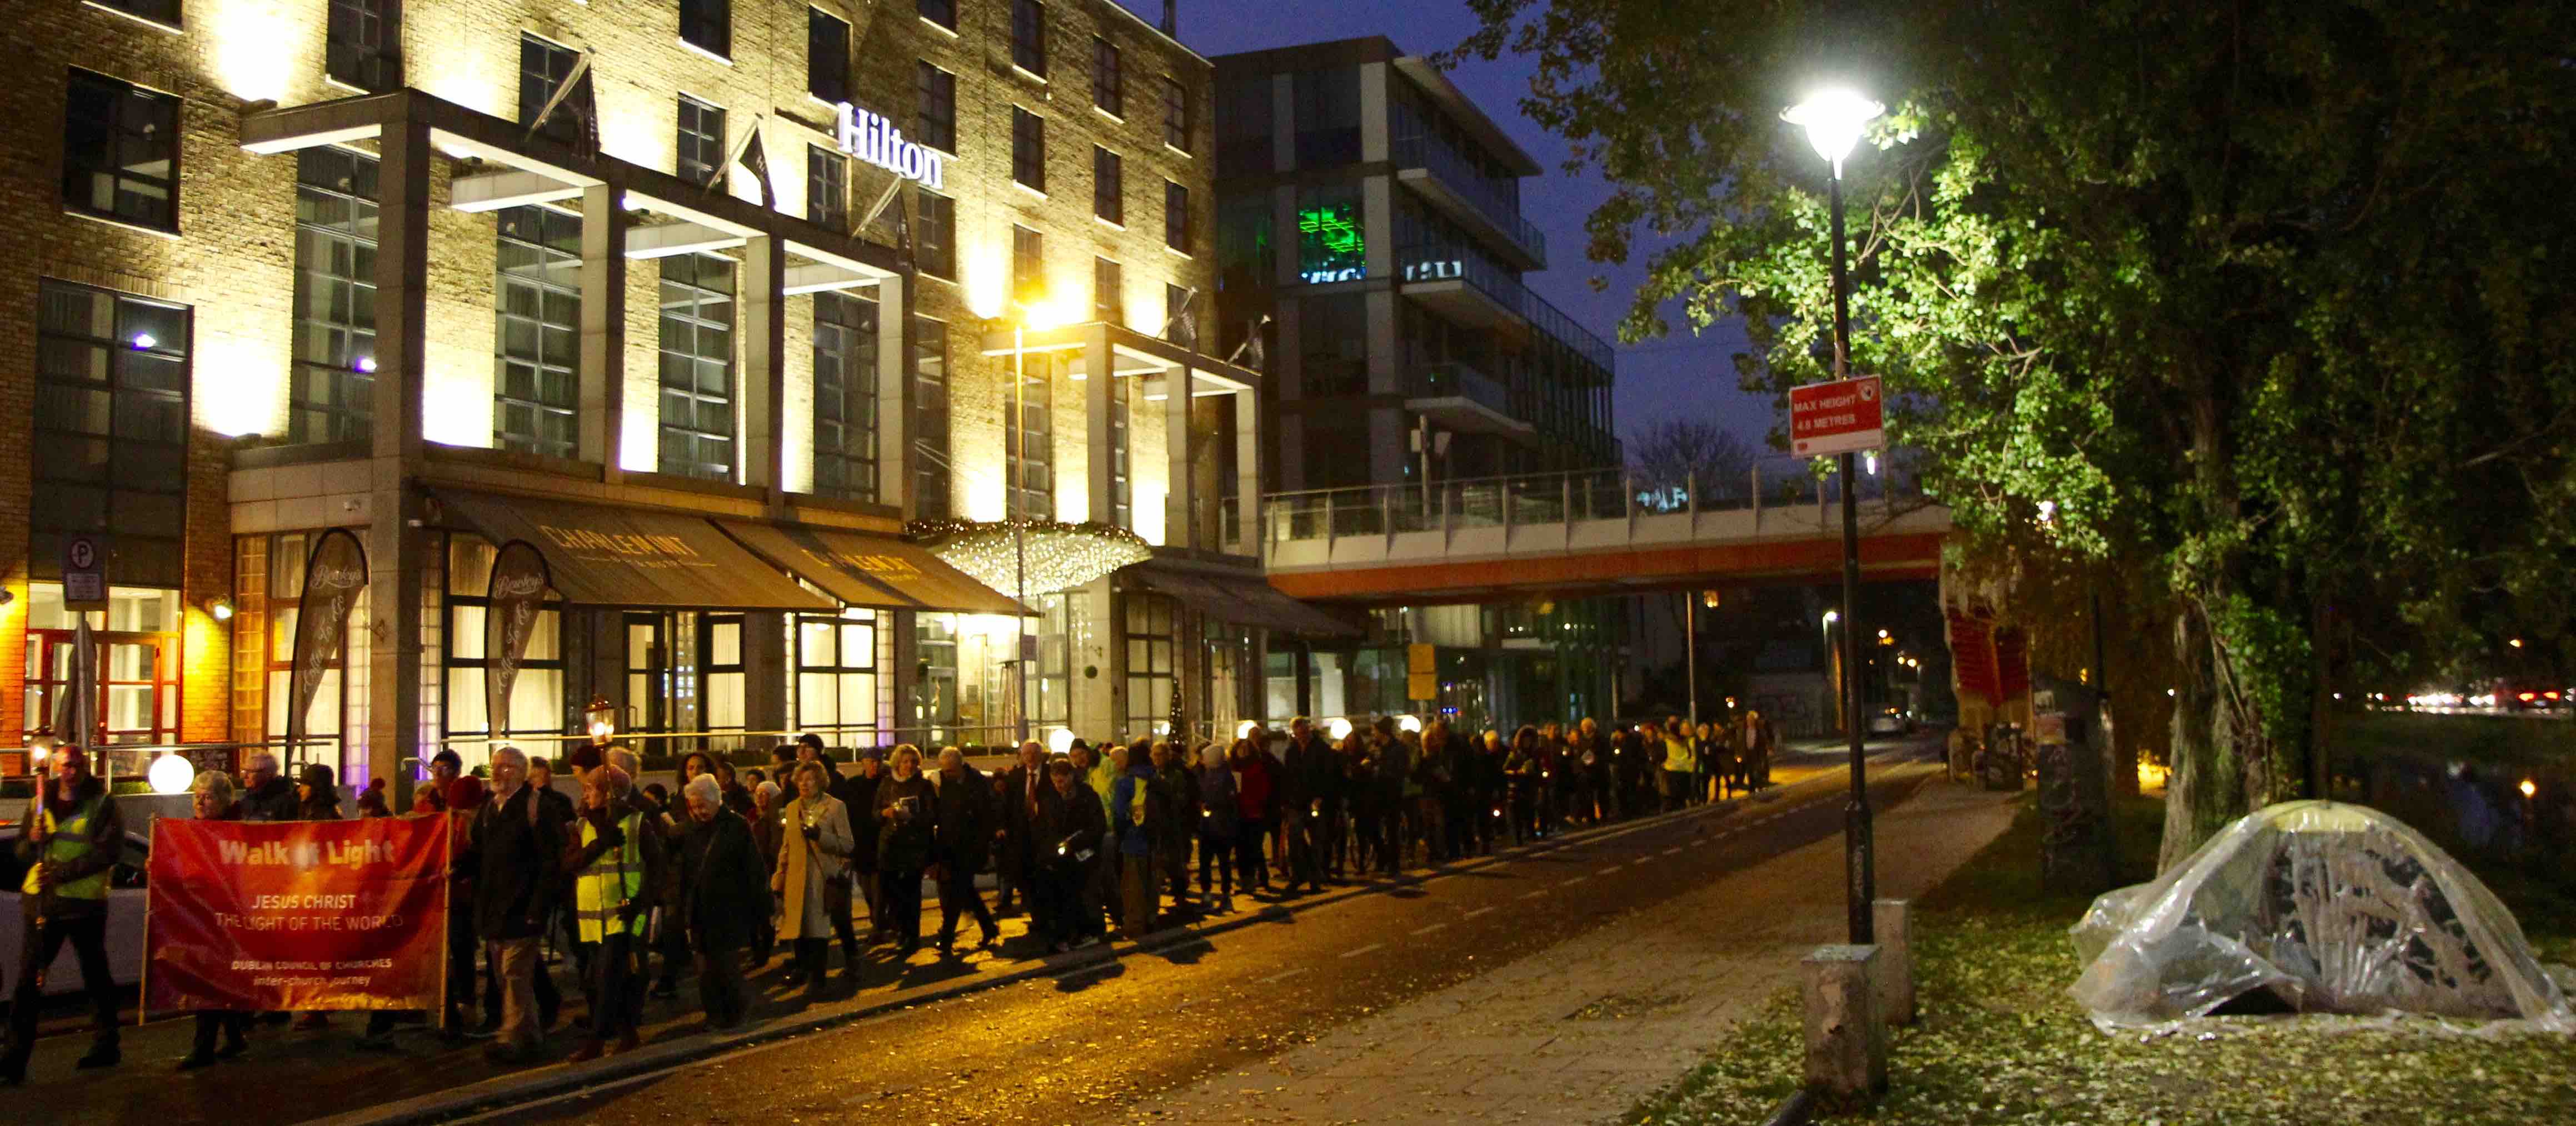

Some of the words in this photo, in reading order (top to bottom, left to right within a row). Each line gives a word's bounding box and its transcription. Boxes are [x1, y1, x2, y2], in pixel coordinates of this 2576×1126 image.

[837, 101, 942, 189] Hilton
[1794, 401, 1817, 412] MAX
[1819, 394, 1855, 409] HEIGHT
[1813, 414, 1855, 428] METRES
[541, 526, 698, 556] CHARLEMONT
[493, 572, 544, 599] Bewley's
[219, 839, 290, 865] Walk
[327, 838, 395, 870] Light
[252, 894, 299, 909] JESUS
[303, 894, 356, 909] CHRIST
[214, 912, 243, 927] THE
[244, 916, 285, 931] LIGHT
[289, 917, 308, 930] OF
[313, 916, 343, 930] THE
